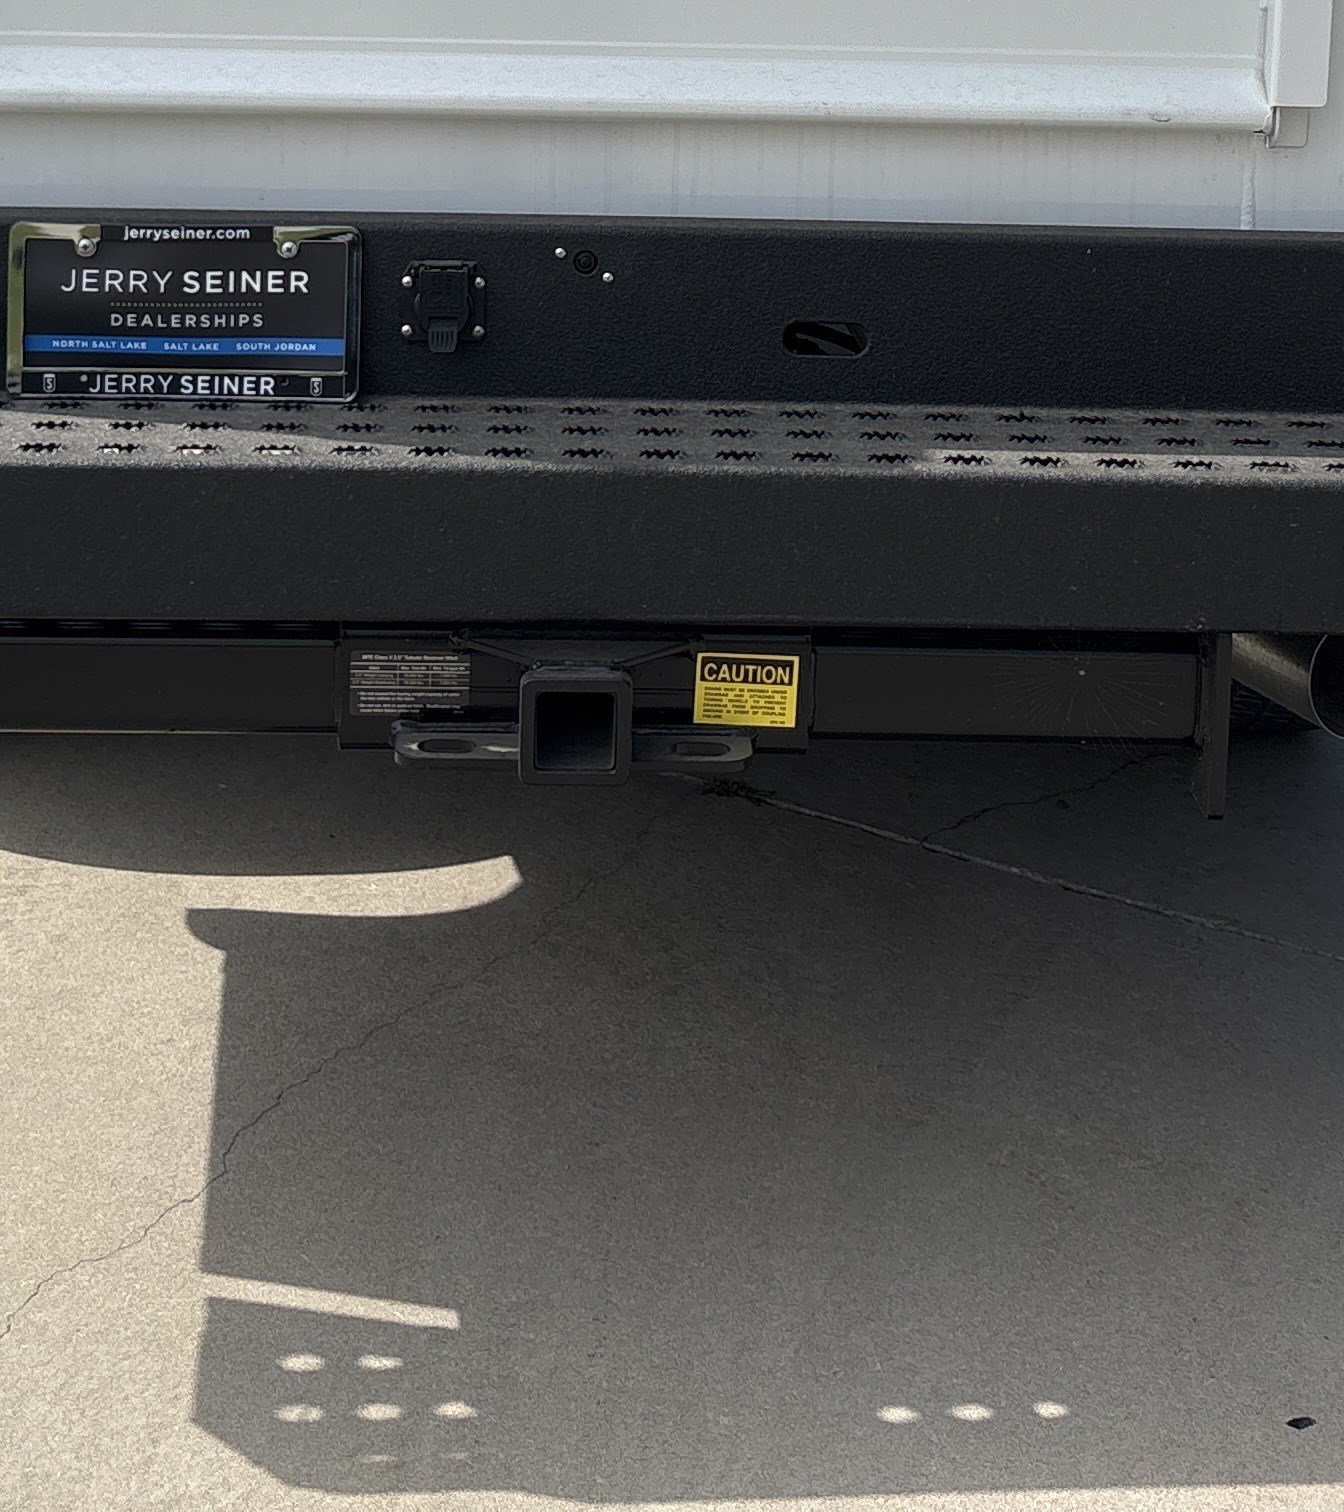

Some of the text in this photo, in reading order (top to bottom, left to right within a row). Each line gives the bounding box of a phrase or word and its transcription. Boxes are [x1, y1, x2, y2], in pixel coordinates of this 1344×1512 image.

[123, 225, 251, 242] jerryseiner.com
[60, 268, 309, 294] JERRY SEINER
[110, 313, 264, 328] DEALERSHIPS
[52, 339, 147, 350] NORTH SALT LAKE
[163, 342, 220, 351] SALT LAKE
[235, 342, 317, 352] SOUTH JORDAN
[88, 373, 276, 396] JERRY SEINER
[703, 662, 790, 684] CAUTION
